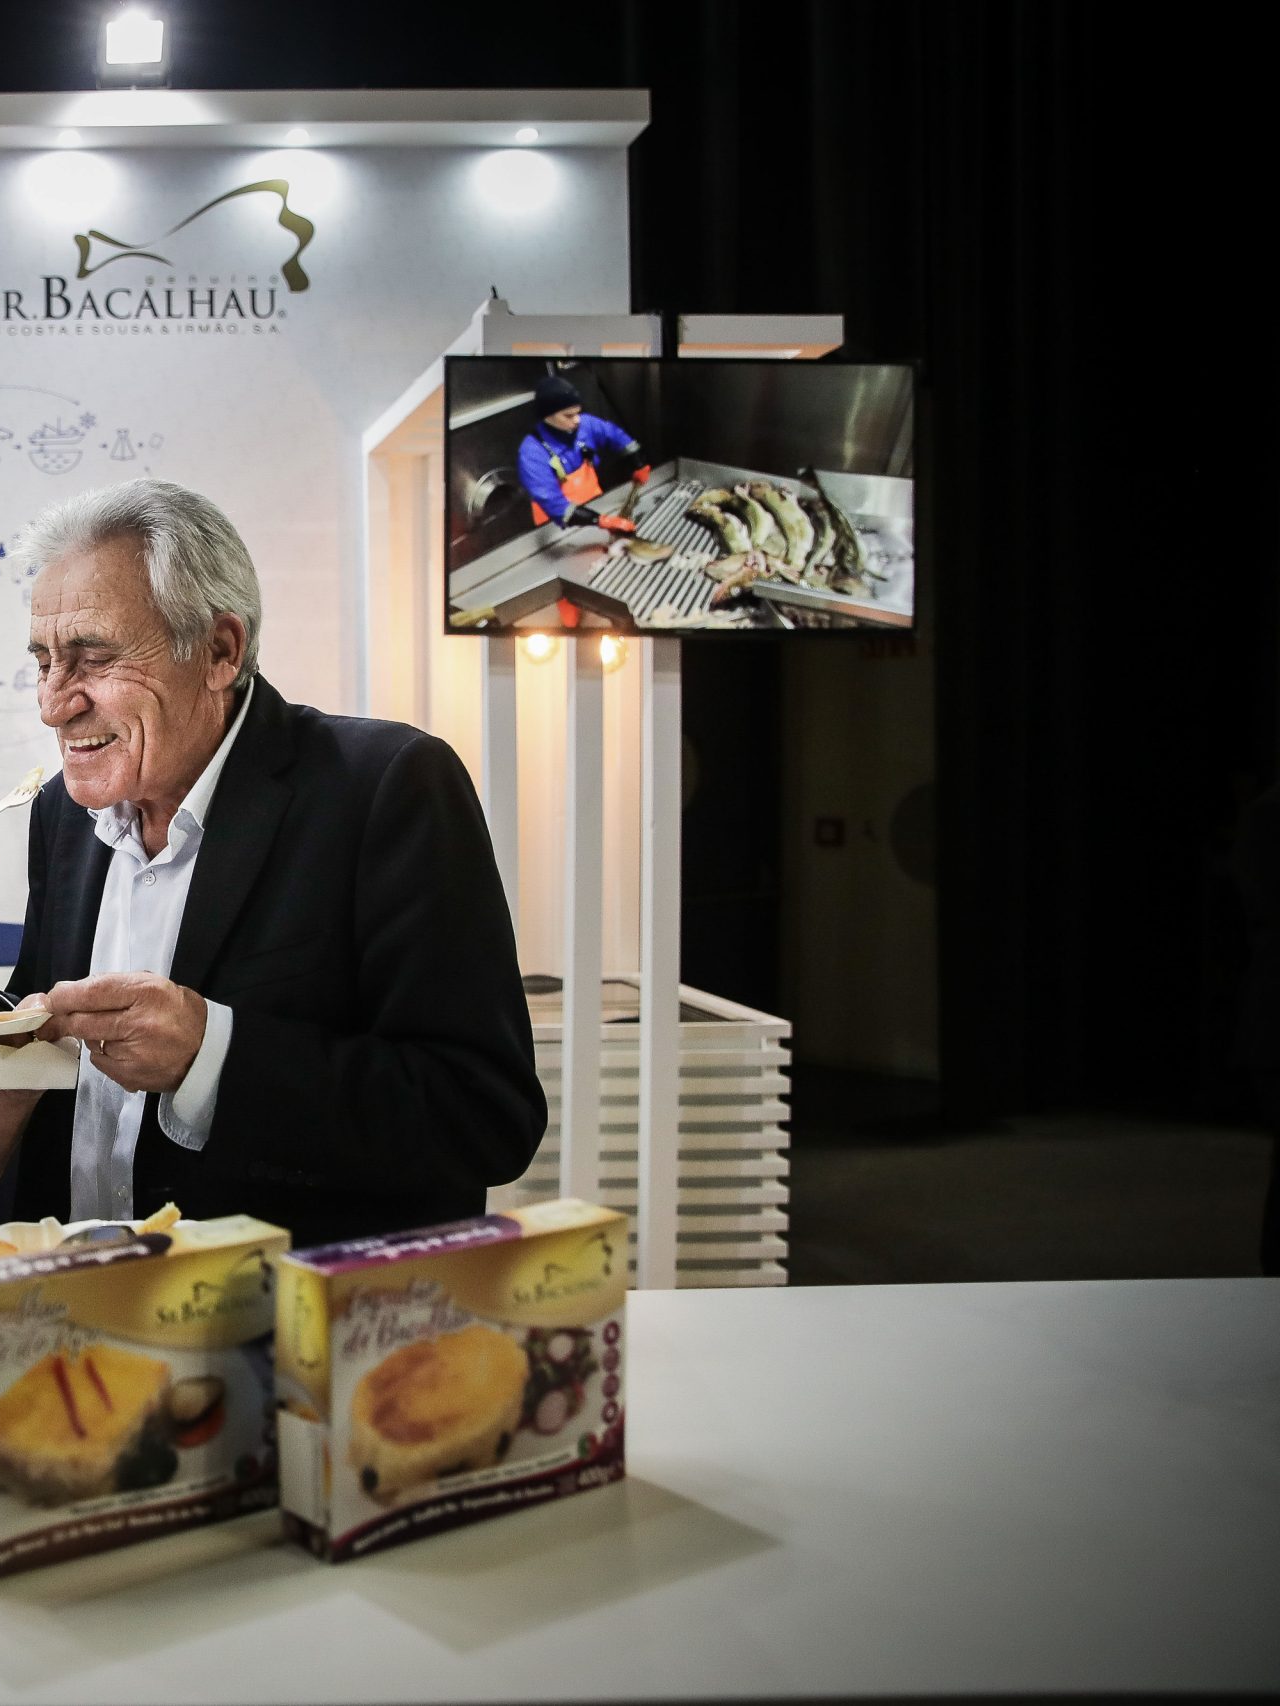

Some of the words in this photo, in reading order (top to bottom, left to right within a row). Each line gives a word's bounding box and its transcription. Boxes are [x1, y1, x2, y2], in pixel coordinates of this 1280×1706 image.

[6, 324, 70, 337] COSTA
[75, 324, 85, 335] E
[90, 324, 153, 336] SOUSA
